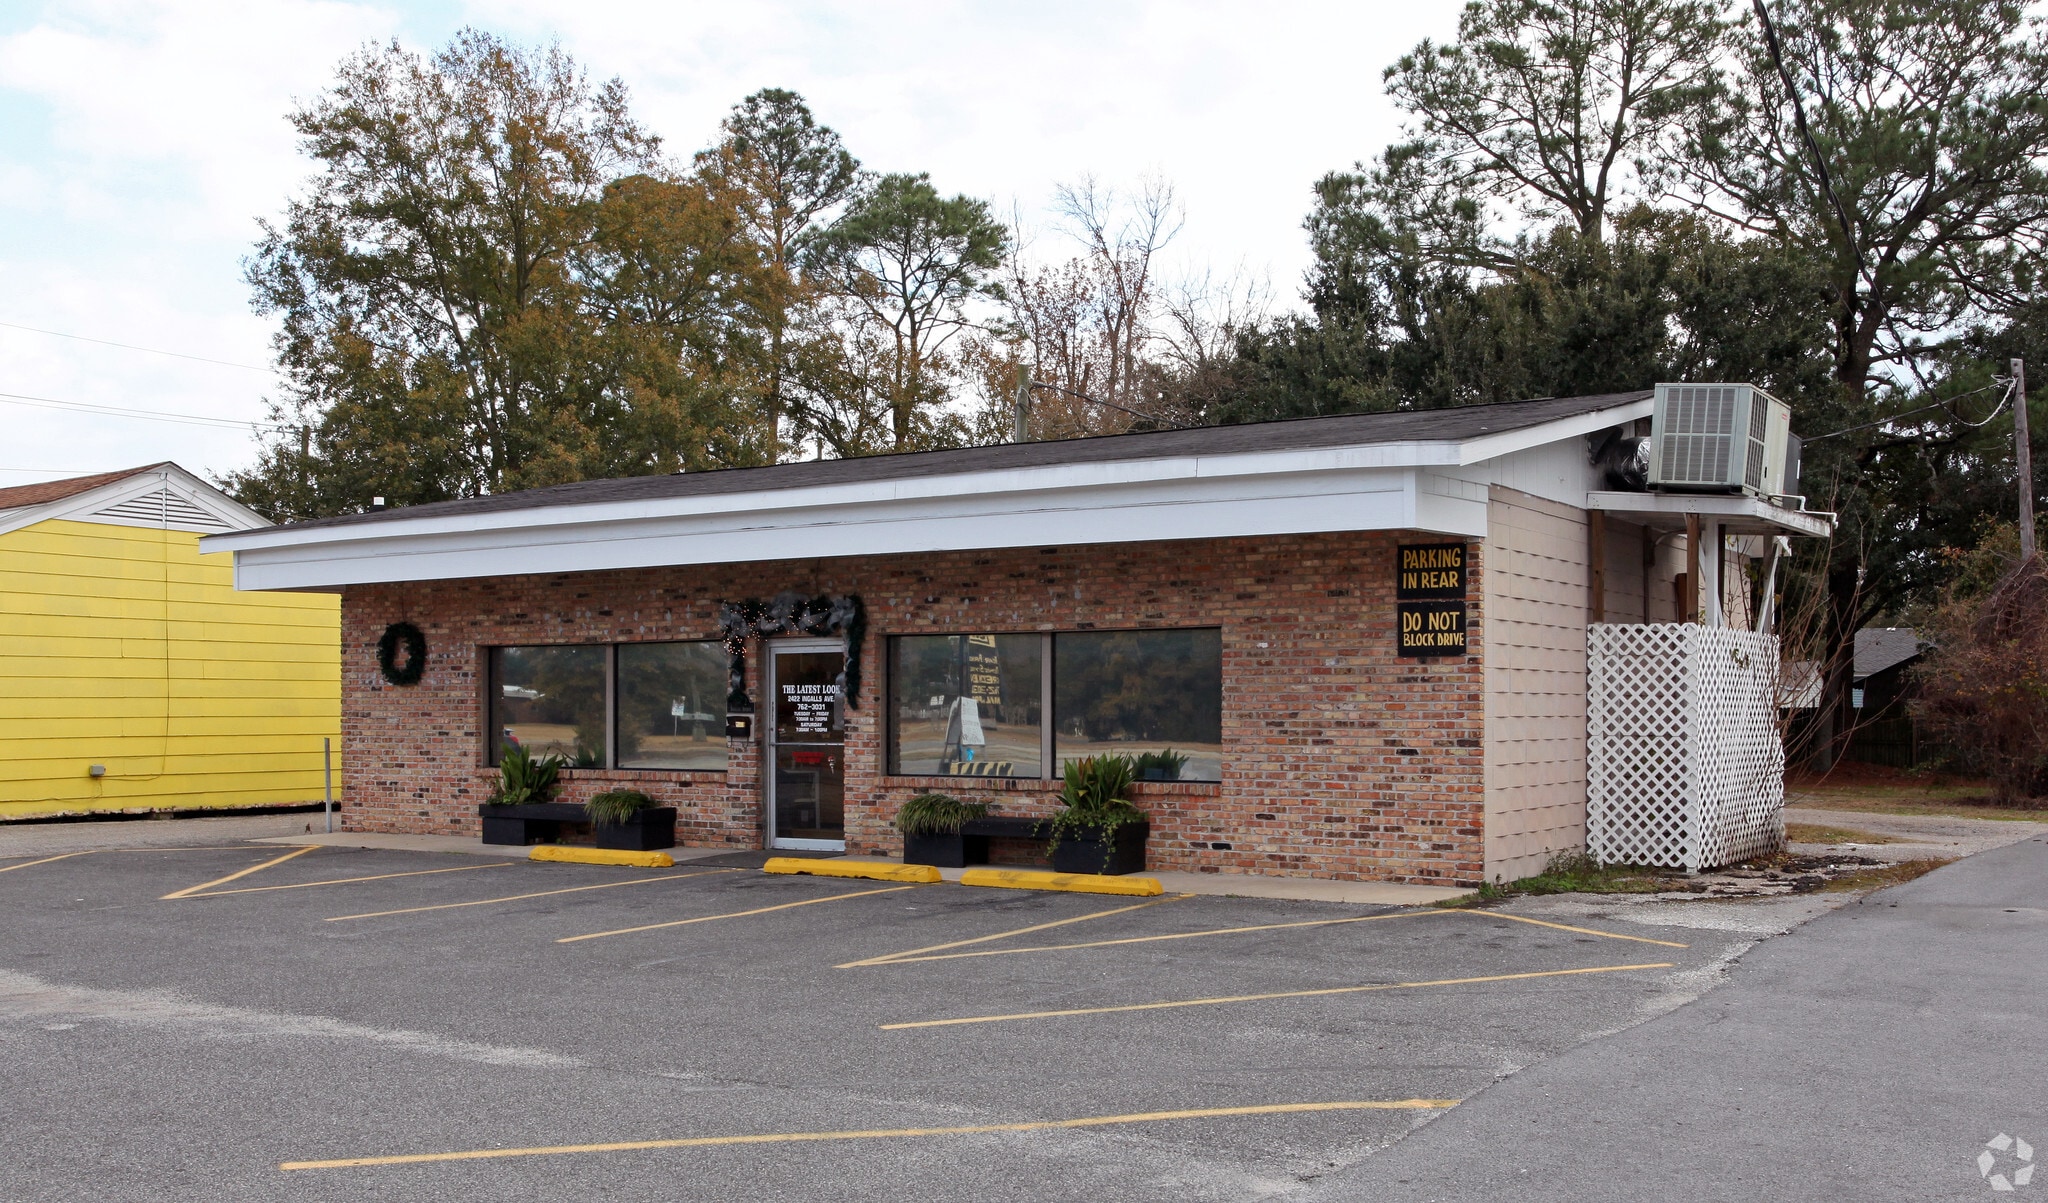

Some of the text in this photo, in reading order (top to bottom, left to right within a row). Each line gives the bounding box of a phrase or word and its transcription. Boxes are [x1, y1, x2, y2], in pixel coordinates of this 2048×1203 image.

[1403, 548, 1461, 569] PARKING
[1403, 571, 1459, 589] IN REAR
[1403, 612, 1460, 632] DO NOT
[1403, 632, 1464, 646] BLOCK DRIVE
[783, 685, 840, 694] THE LATEST LOOK
